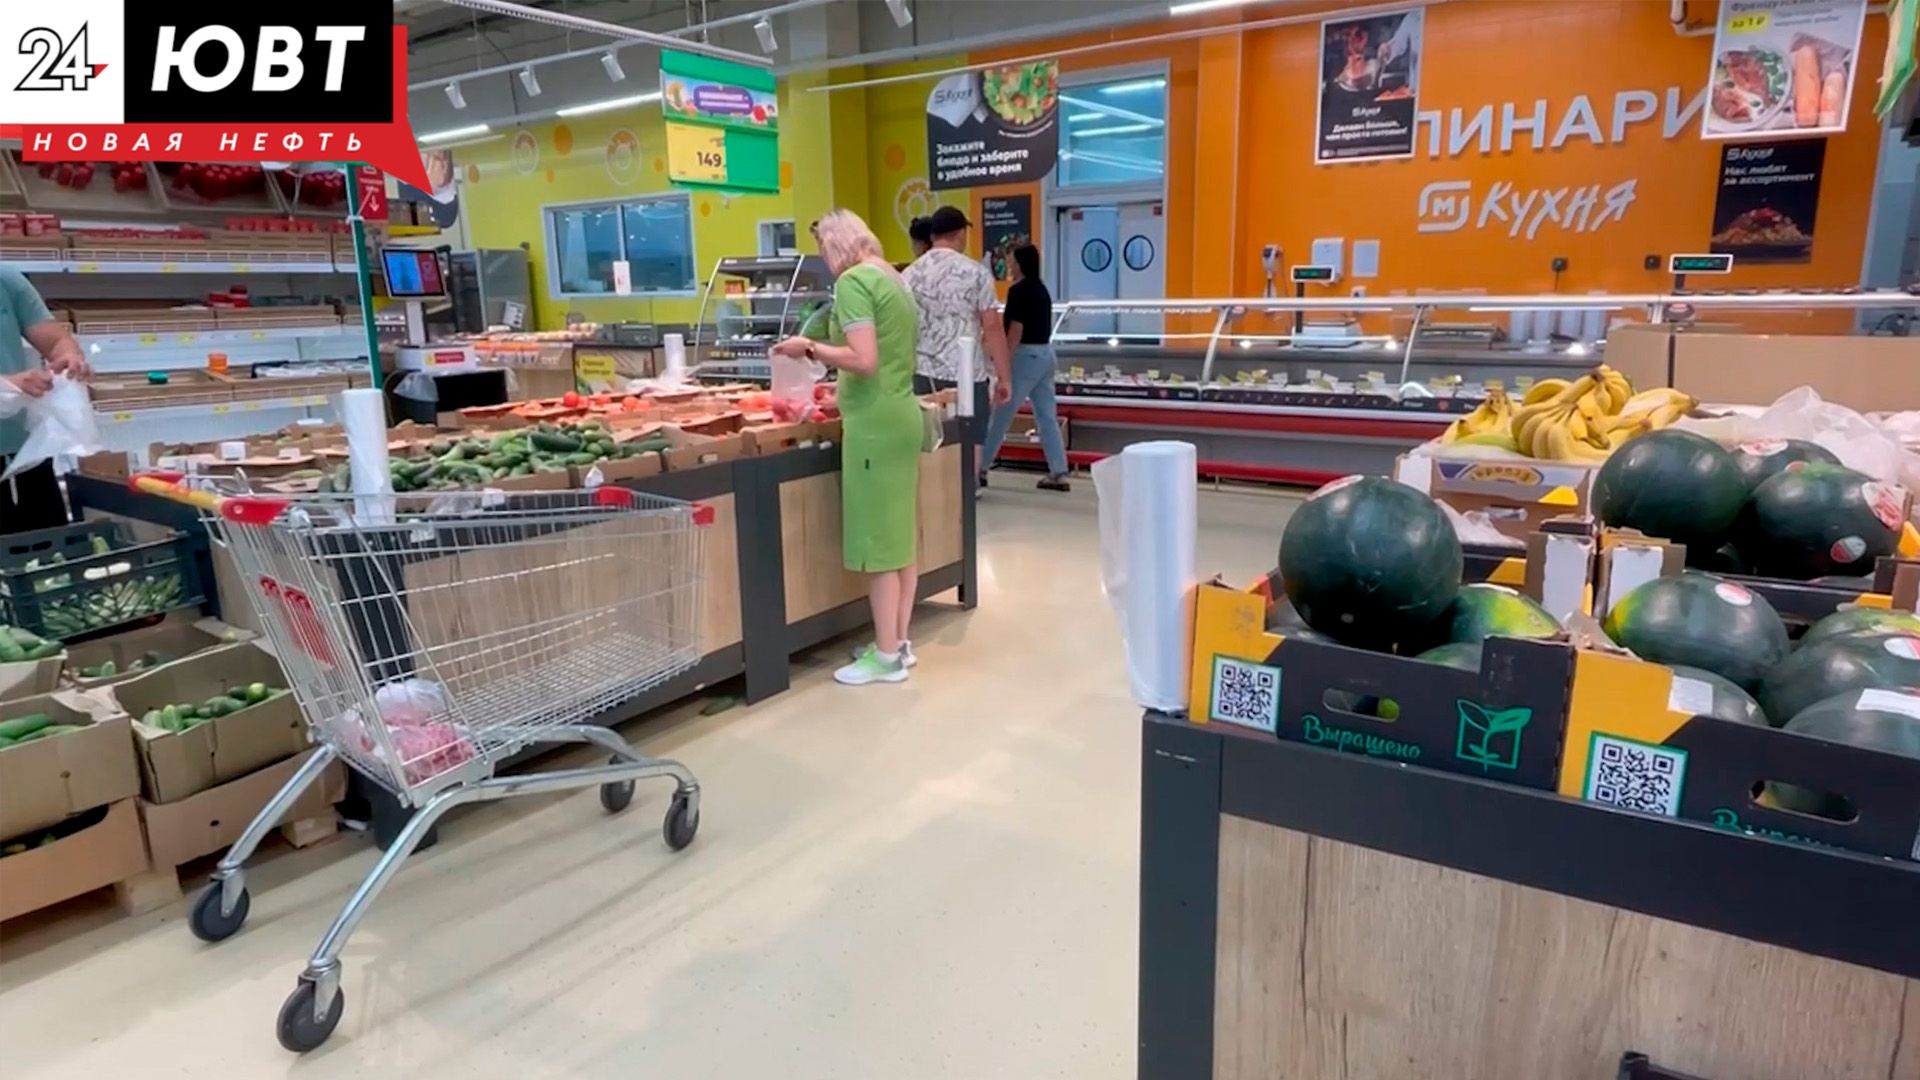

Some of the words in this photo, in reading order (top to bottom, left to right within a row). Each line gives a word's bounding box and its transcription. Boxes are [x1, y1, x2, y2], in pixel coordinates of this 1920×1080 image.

[937, 142, 985, 154] Закажите
[697, 152, 722, 167] 149
[937, 157, 970, 167] блюдо
[980, 149, 1029, 162] заберите
[945, 165, 988, 182] удобное
[989, 163, 1022, 175] время
[1725, 167, 1748, 175] Нас
[1748, 164, 1789, 175] любят
[1723, 178, 1737, 186] за
[1302, 715, 1420, 758] Выращено
